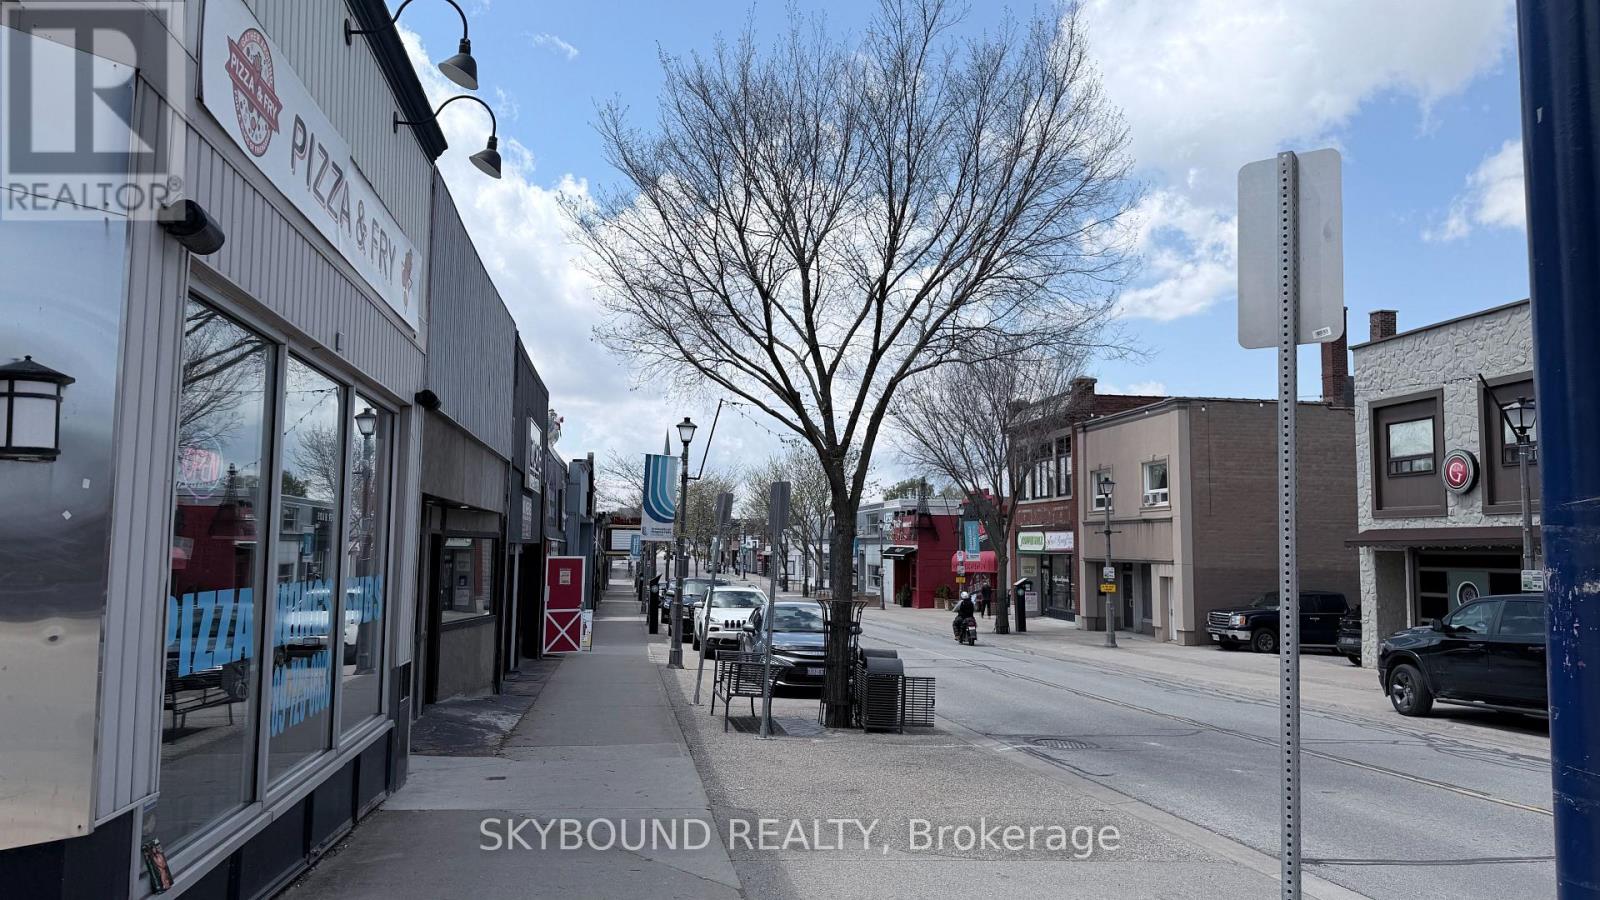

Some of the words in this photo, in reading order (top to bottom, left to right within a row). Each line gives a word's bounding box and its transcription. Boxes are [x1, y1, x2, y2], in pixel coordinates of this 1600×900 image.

[230, 54, 255, 93] PIZZA
[256, 86, 263, 105] &
[263, 94, 277, 120] FRY
[290, 113, 352, 239] PIZZA
[356, 199, 366, 256] &
[371, 217, 397, 287] FRY
[1449, 462, 1463, 483] G
